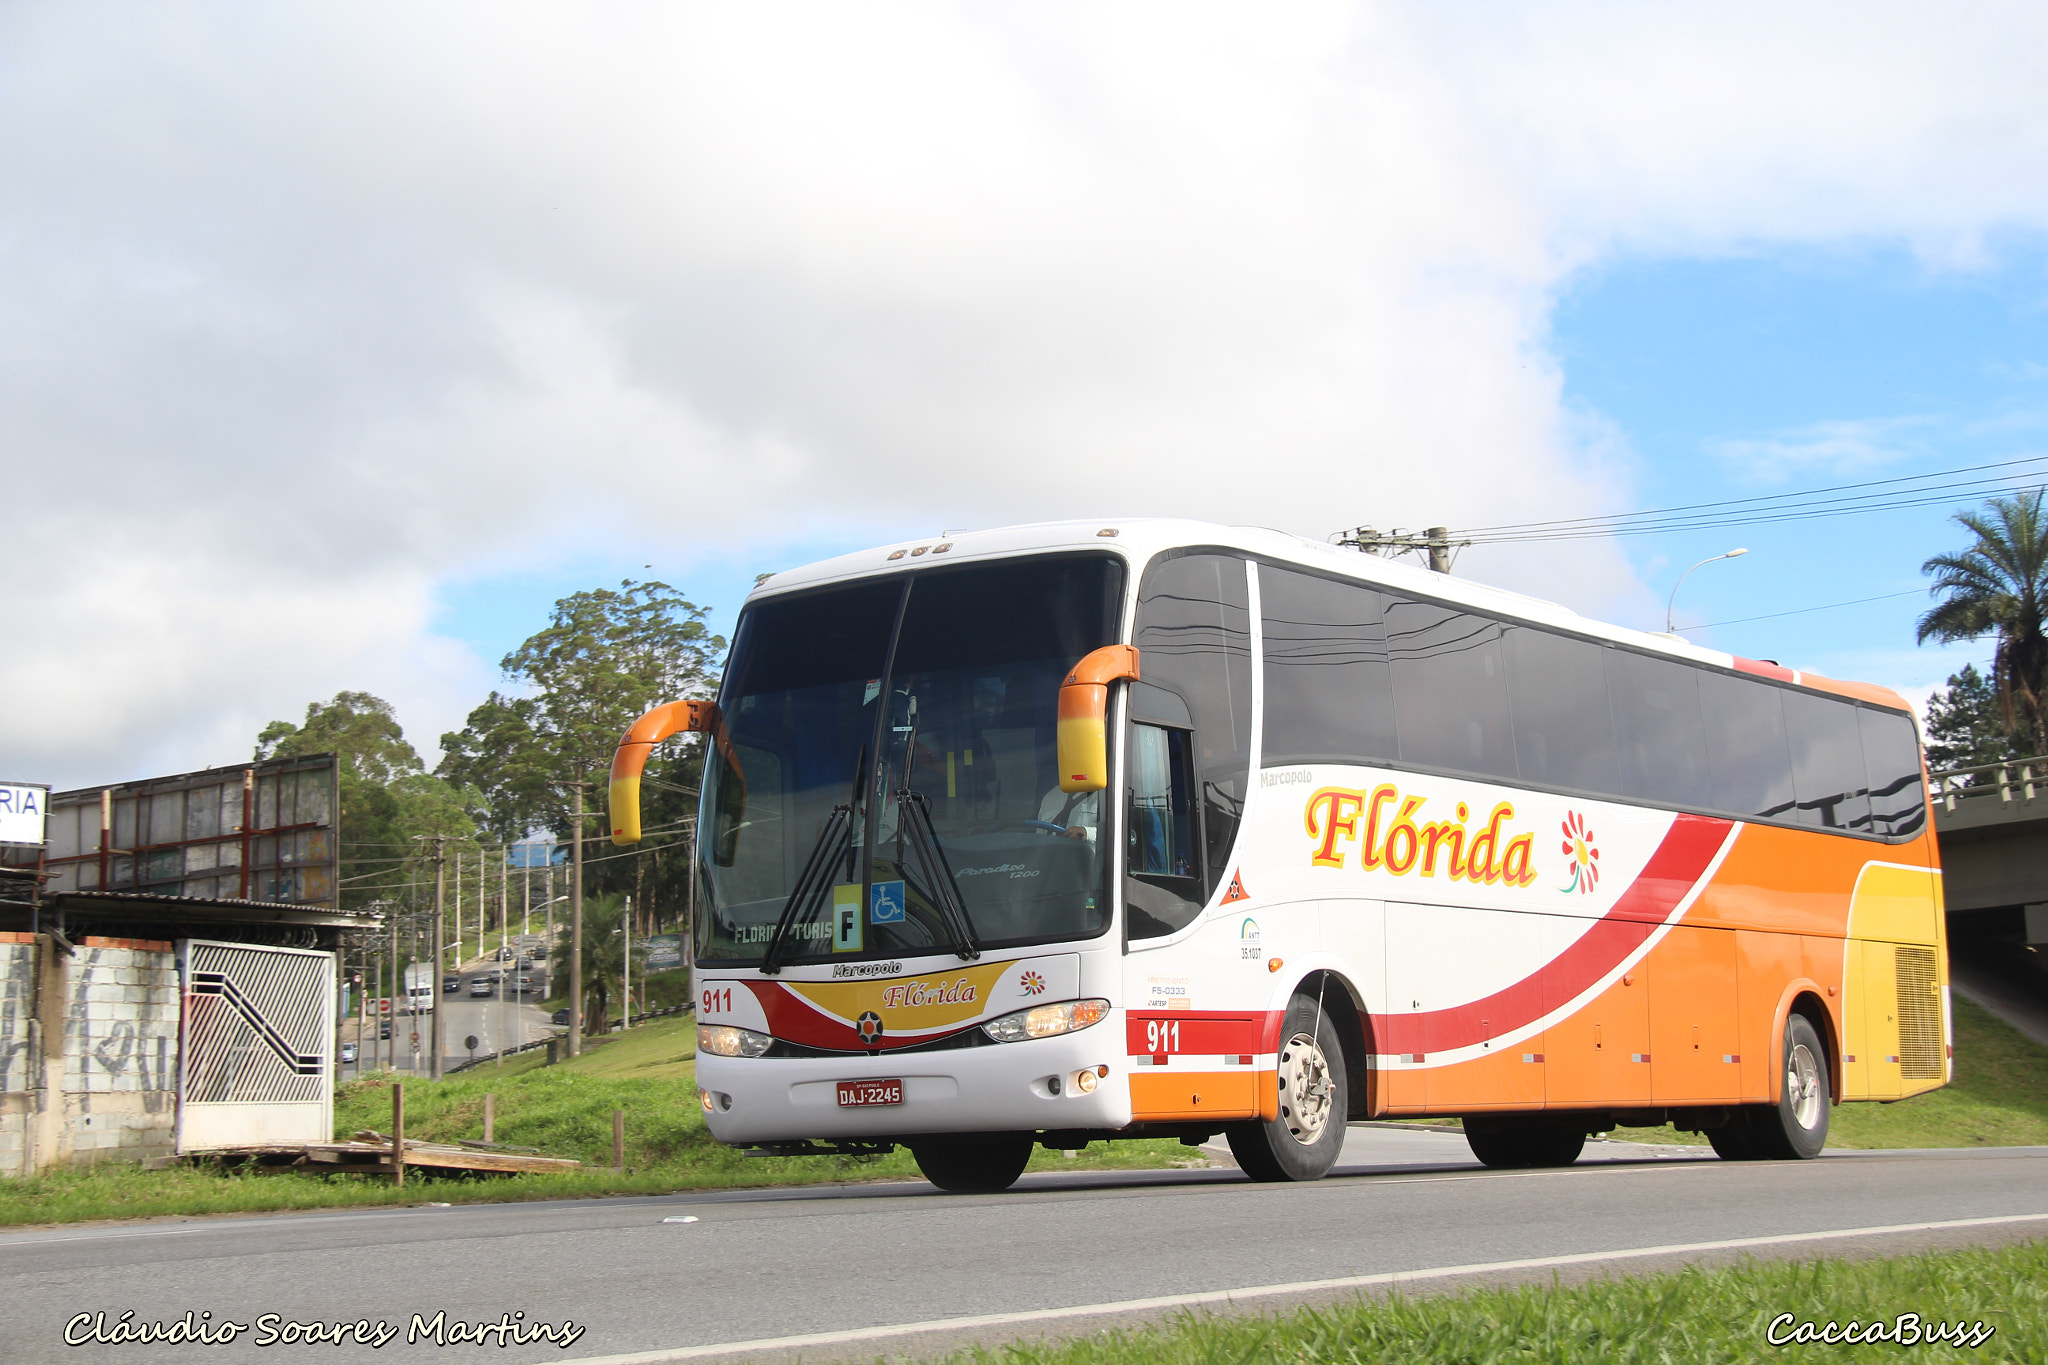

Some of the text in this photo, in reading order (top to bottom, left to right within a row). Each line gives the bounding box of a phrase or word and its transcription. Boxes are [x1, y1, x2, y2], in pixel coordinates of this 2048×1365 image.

[1261, 769, 1312, 788] Marcopolo
[1304, 783, 1538, 888] Flórida
[1009, 870, 1040, 879] 1200
[842, 911, 854, 942] F
[832, 960, 903, 978] Marcopolo
[703, 986, 733, 1014] 911
[882, 977, 978, 1010] Flórida
[1147, 1020, 1180, 1053] 911
